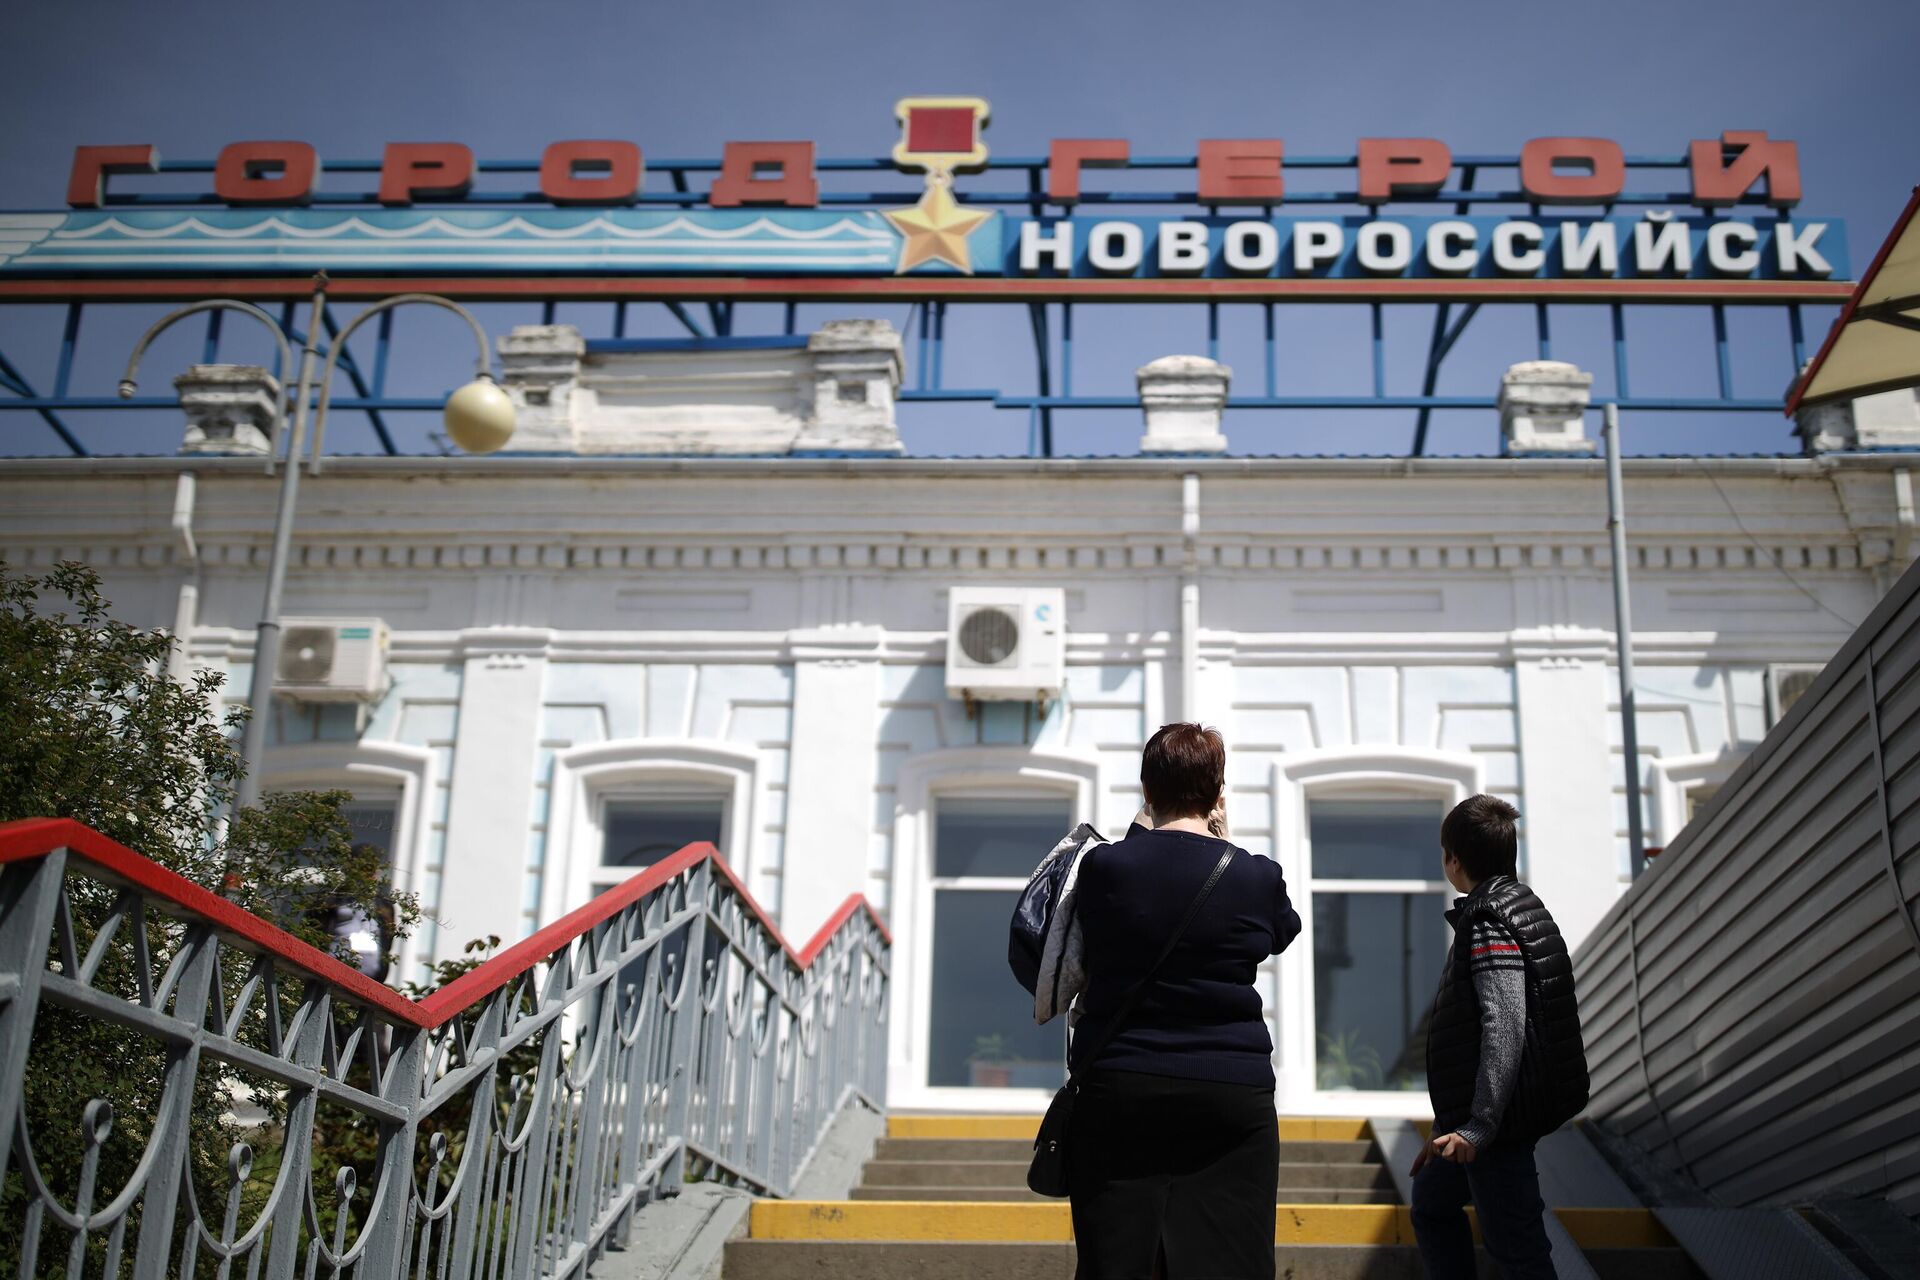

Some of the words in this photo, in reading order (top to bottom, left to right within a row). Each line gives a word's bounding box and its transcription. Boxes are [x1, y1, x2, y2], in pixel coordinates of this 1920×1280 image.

[66, 140, 819, 207] ГОРОД
[1048, 130, 1801, 201] ГЕРОЙ
[1019, 210, 1832, 274] НОВОРОССИЙСК
